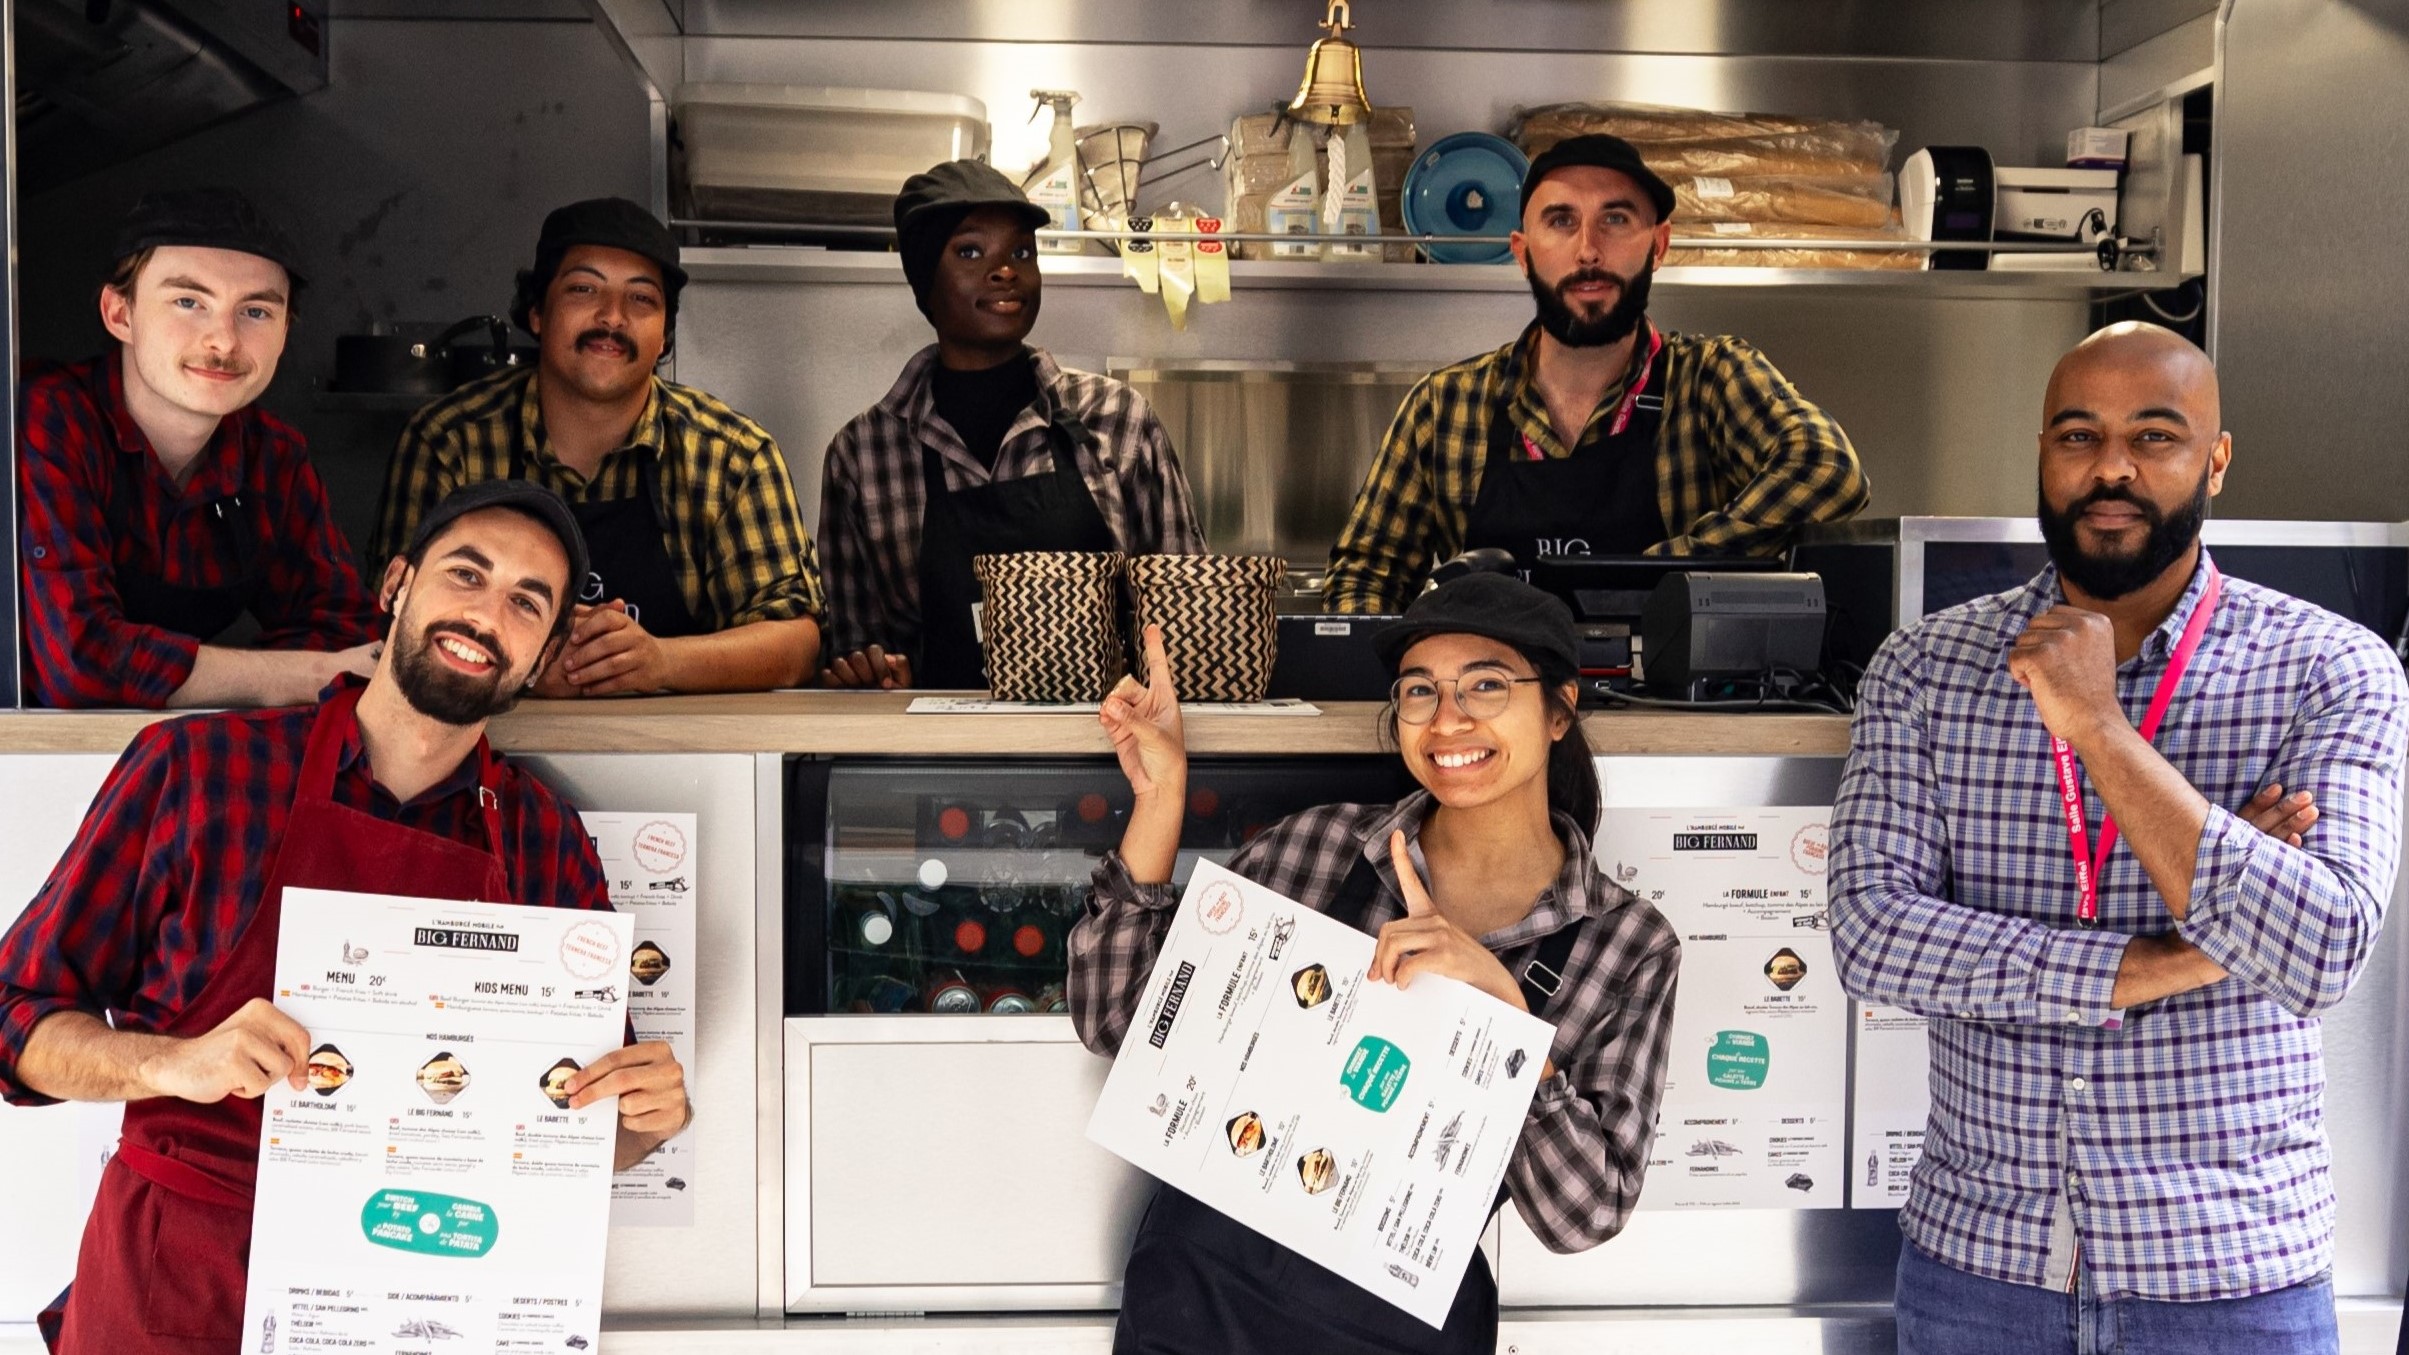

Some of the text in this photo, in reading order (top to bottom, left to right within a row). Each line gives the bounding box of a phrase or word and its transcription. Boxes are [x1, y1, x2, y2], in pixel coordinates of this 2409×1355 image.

[2061, 752, 2077, 802] Gustave
[2070, 801, 2082, 834] Salle
[1675, 835, 1757, 849] BIG FERNAND
[2079, 860, 2089, 893] Eiffel
[1731, 889, 1768, 899] FORMULE
[1800, 889, 1812, 899] 15€
[416, 929, 517, 950] BIG FERNAND
[326, 971, 387, 986] MENU 20€
[1217, 927, 1259, 1019] LA FORMULE ENFANT 15€
[474, 981, 556, 997] KIDS MENU 15€
[1153, 963, 1193, 1046] BIG FERNAND
[544, 1115, 569, 1123] BABETTE
[1163, 1074, 1198, 1147] LA FORMULE 20€
